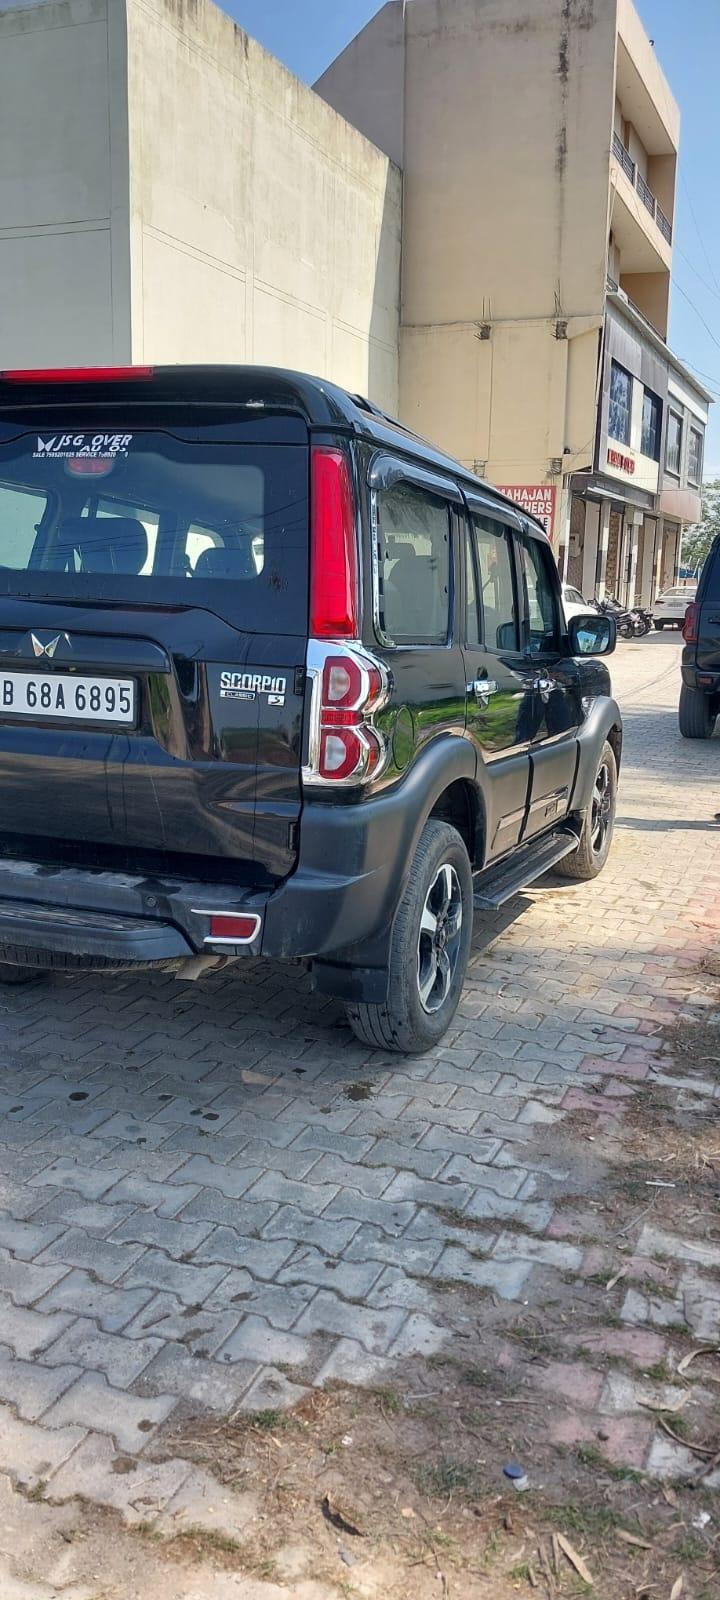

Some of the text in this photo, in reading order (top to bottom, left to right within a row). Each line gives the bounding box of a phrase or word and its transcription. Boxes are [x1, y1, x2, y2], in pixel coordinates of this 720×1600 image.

[2, 680, 131, 714] B 68A 6895
[220, 671, 287, 695] SCORPIO
